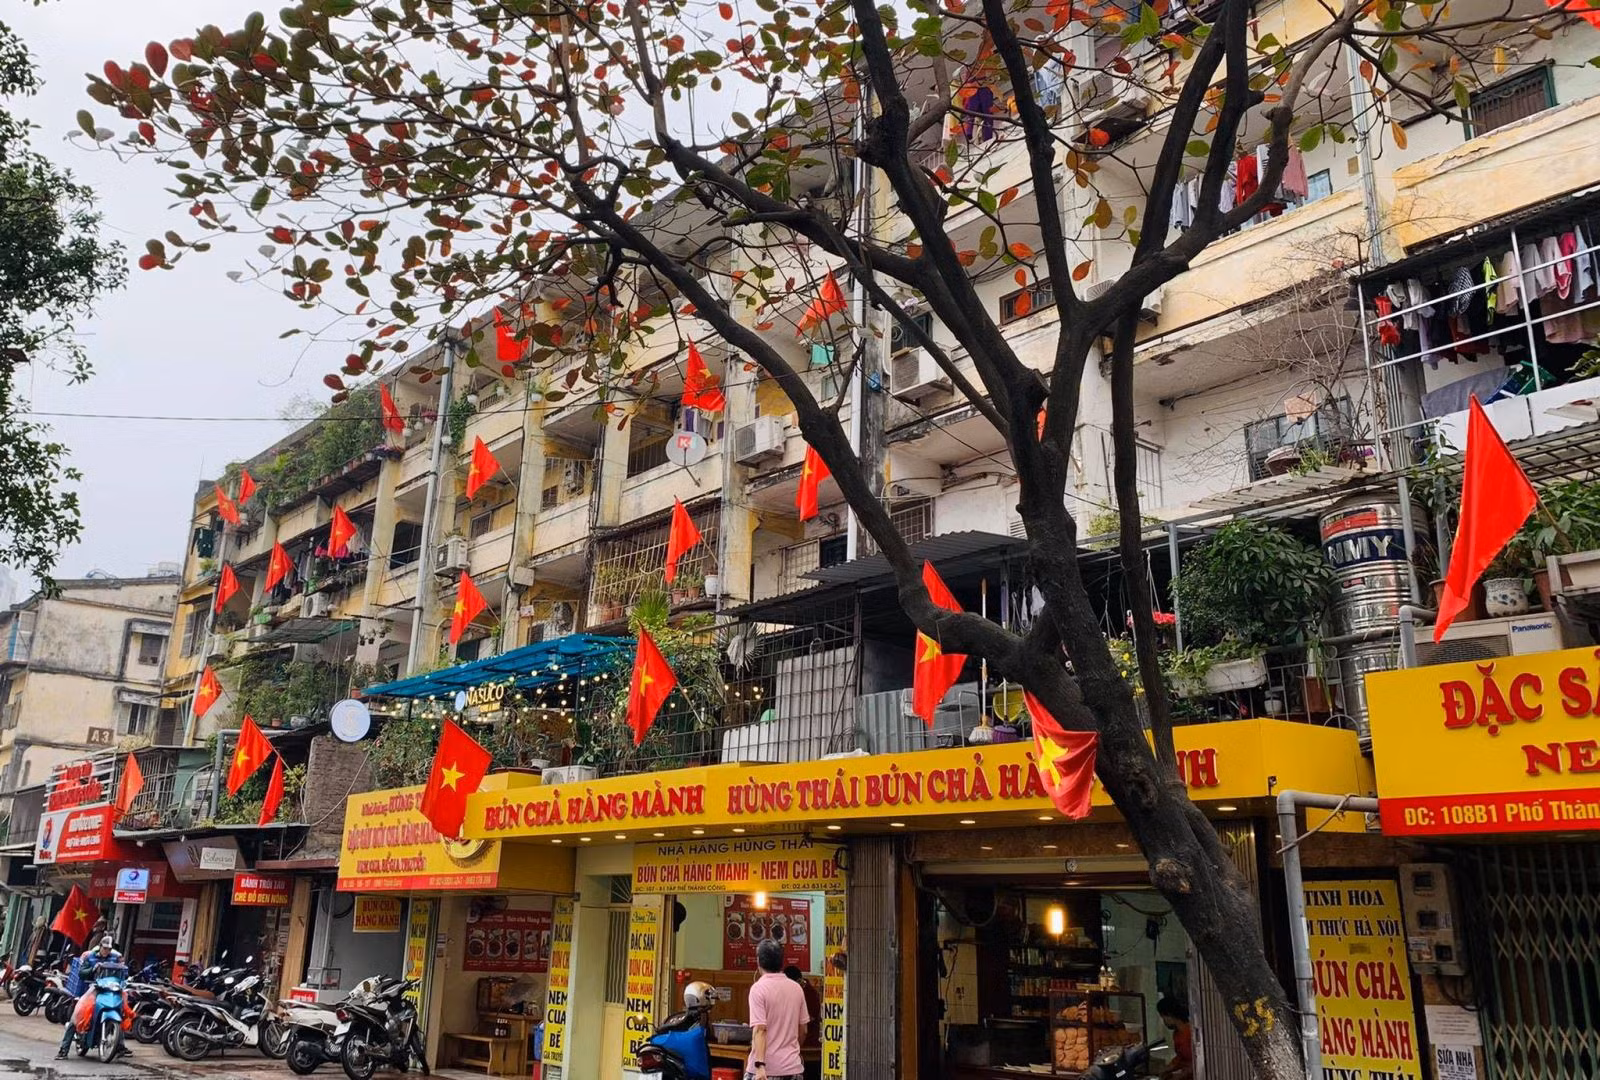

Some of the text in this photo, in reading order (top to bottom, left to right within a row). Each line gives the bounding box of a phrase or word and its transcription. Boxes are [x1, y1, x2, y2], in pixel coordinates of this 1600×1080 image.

[1511, 622, 1552, 632] Panasonic
[1440, 649, 1600, 736] ĐẶC S
[727, 776, 793, 815] HÙNG
[927, 752, 992, 803] CHẢ
[524, 789, 564, 827] CHẢ
[567, 787, 627, 824] HÀNG
[631, 779, 704, 819] MÀNH
[1404, 806, 1436, 827] ĐC:
[1441, 803, 1498, 825] 108B1
[1505, 798, 1544, 823] Phố
[734, 837, 776, 852] HÙNG
[637, 862, 657, 883] BÚN
[660, 857, 680, 882] CHẢ
[683, 861, 712, 882] HÀNG
[715, 858, 750, 881] MÀNH
[761, 861, 788, 880] NEM
[1347, 890, 1384, 906] HOA
[1317, 917, 1350, 942] THỰC
[1354, 915, 1373, 936] HÀ
[1355, 946, 1406, 1000] CHẢ
[626, 998, 651, 1014] NEM
[1321, 1005, 1357, 1056] ÀNG
[1359, 1008, 1413, 1060] MÀNH
